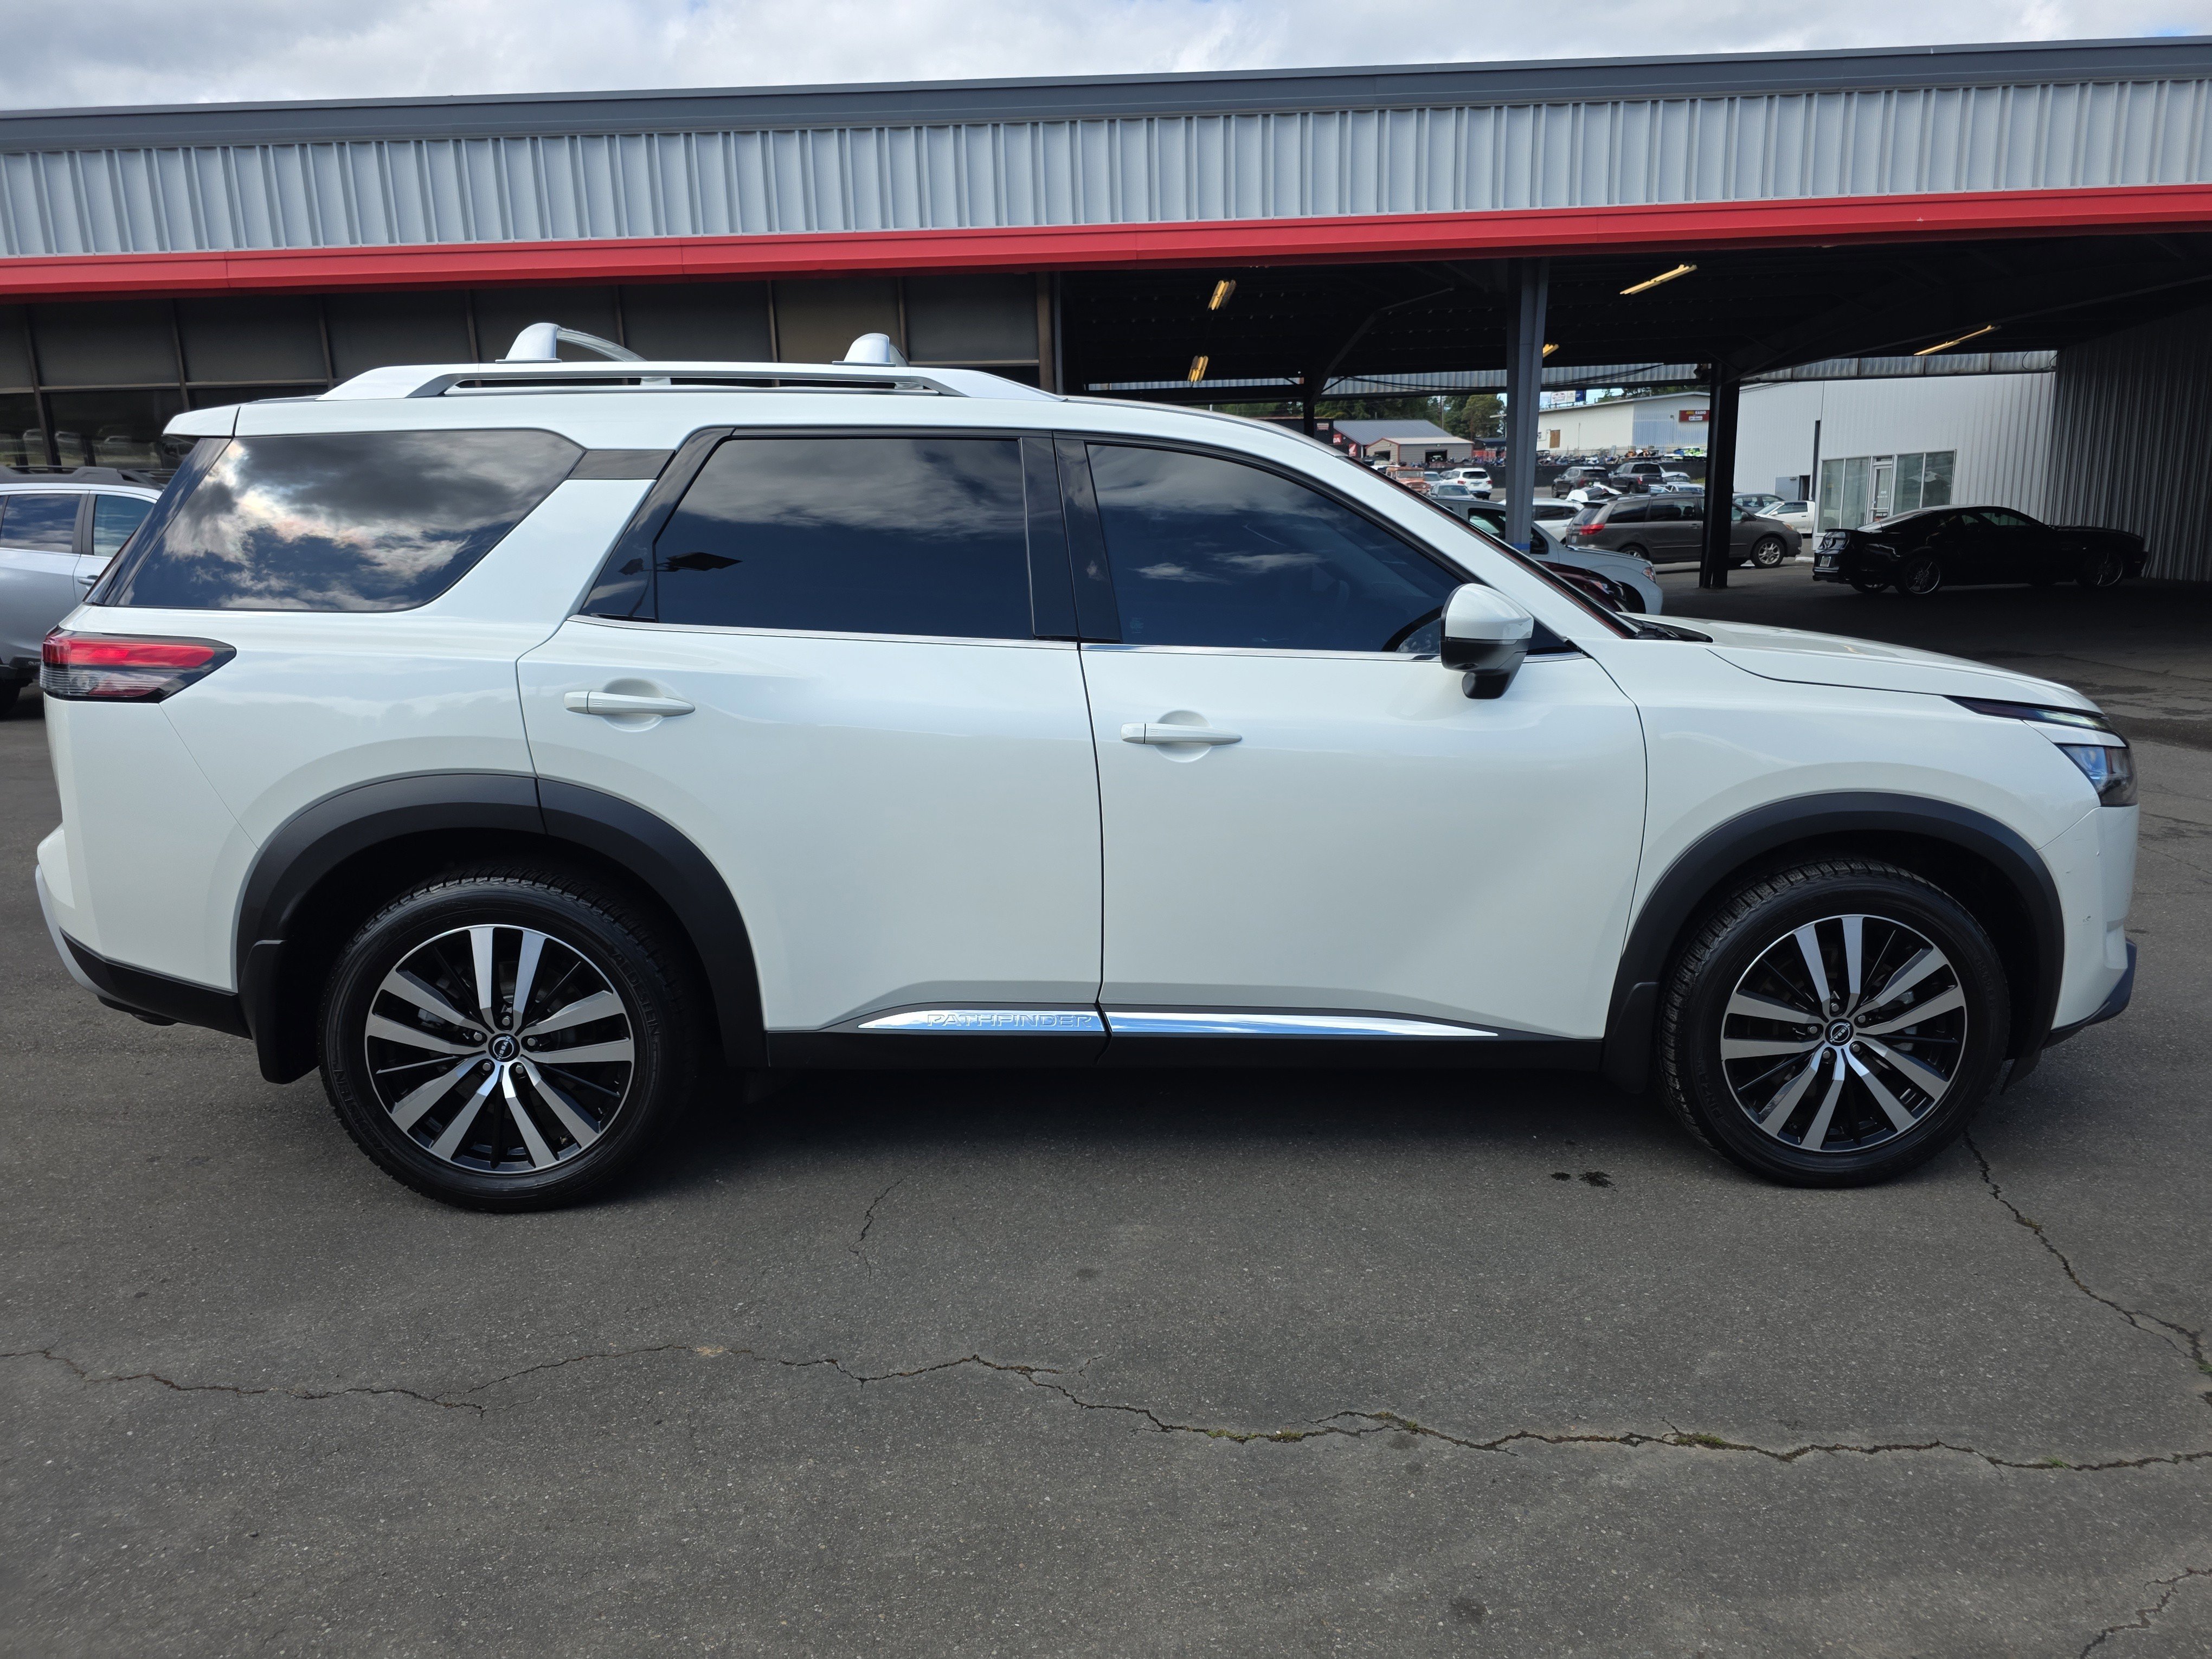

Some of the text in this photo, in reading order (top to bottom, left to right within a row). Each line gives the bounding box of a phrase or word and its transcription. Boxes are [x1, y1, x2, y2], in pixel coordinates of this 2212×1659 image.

[927, 1014, 1091, 1027] PATHFINDER
[1829, 1022, 1850, 1043] NISSAN
[497, 1036, 512, 1060] NISSAN
